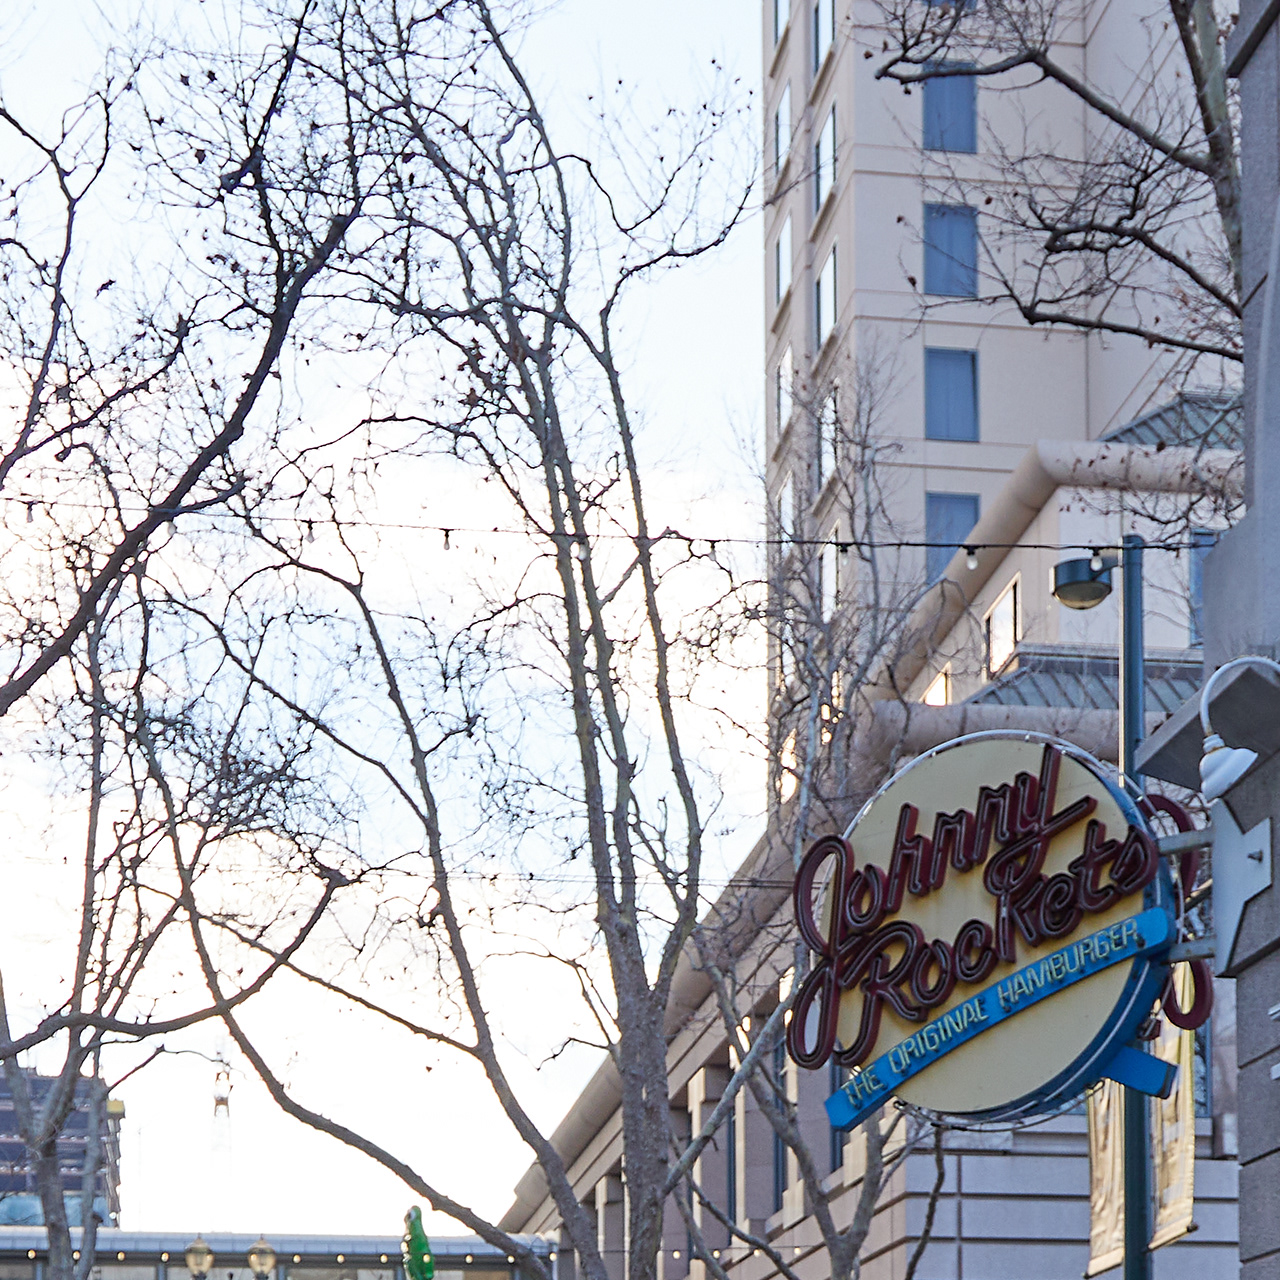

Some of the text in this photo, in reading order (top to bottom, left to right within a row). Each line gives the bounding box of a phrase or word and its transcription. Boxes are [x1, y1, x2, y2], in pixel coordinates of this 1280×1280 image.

[786, 743, 1098, 1070] Johnny
[834, 818, 1158, 1066] Rockets
[841, 917, 1139, 1109] THE ORIGINAL HAMBURGER
